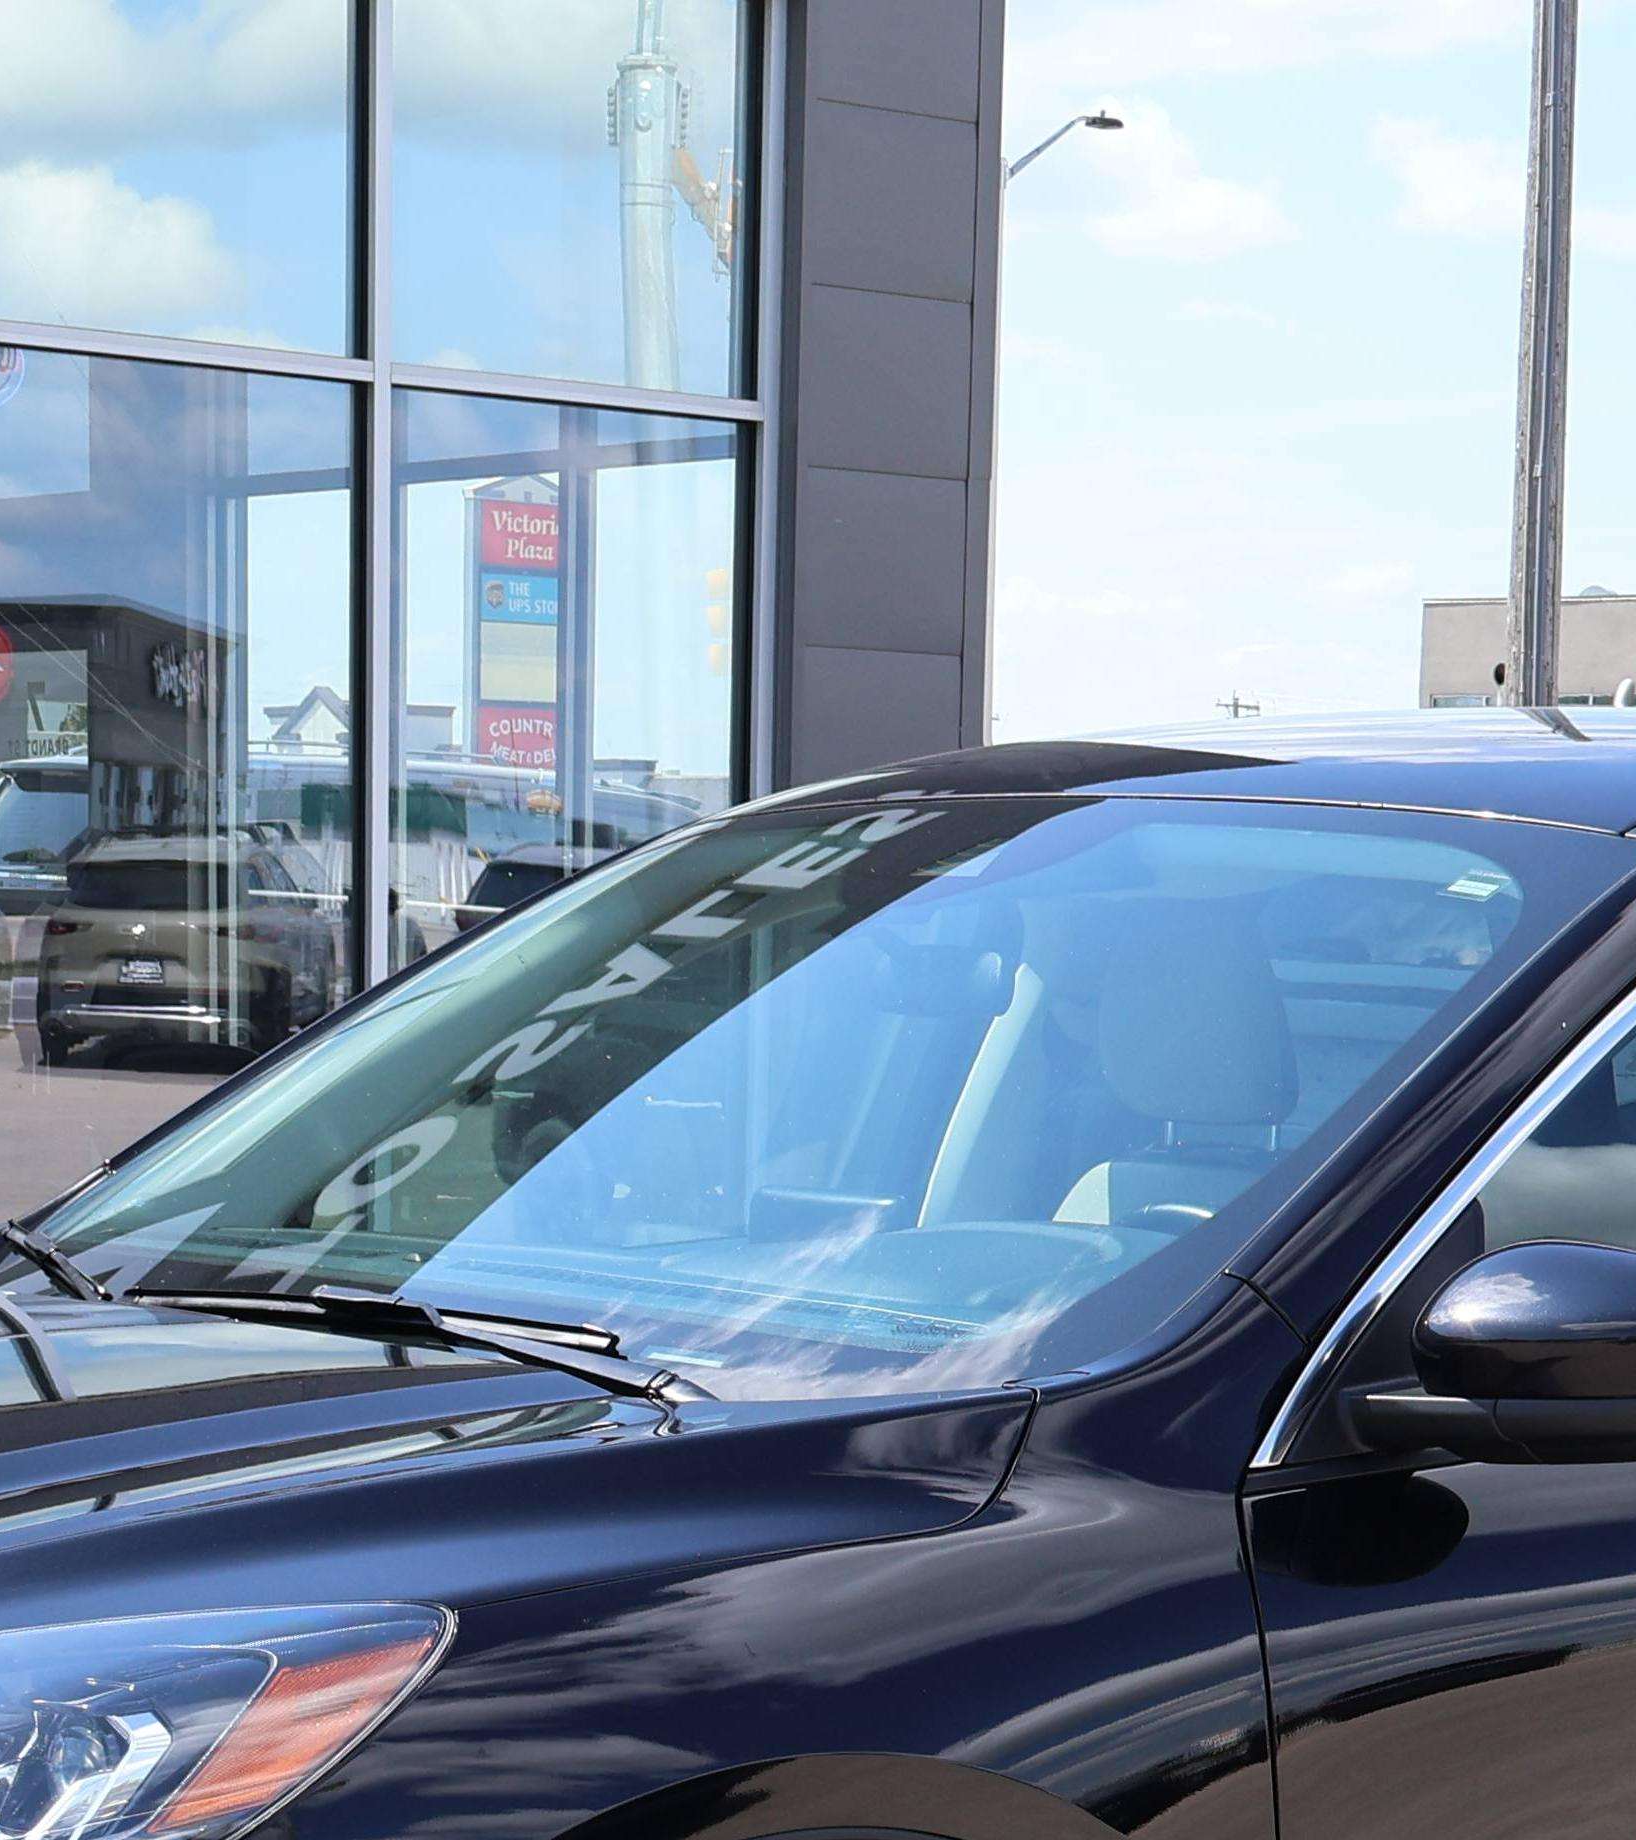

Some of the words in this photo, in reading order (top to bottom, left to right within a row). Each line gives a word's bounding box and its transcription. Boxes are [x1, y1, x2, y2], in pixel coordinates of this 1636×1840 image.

[492, 510, 559, 536] Victori
[505, 536, 555, 561] Plaza
[508, 581, 531, 598] THE
[508, 598, 532, 614] UPS
[534, 600, 559, 616] STO
[488, 718, 554, 738] COUNTR
